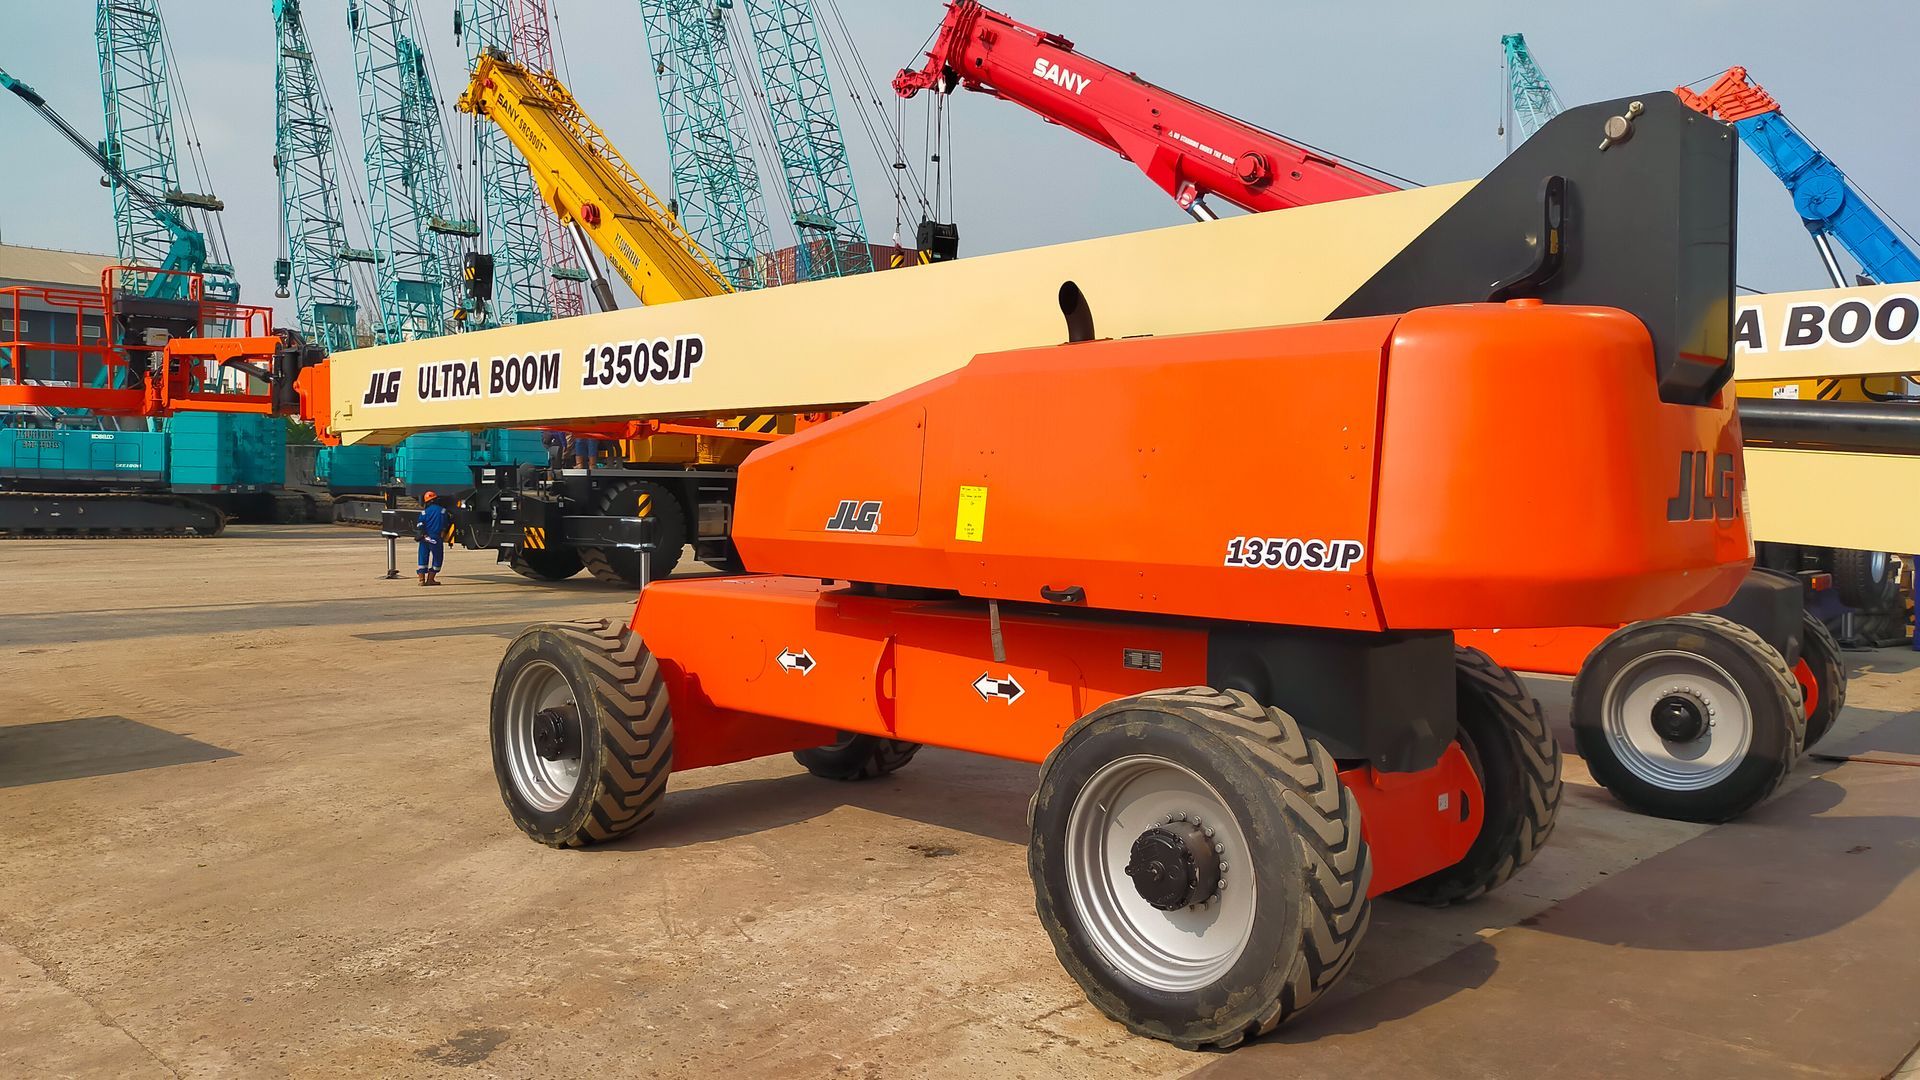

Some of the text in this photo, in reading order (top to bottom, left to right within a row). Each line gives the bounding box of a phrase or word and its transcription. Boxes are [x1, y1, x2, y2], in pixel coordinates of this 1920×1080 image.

[1032, 57, 1092, 96] SANY
[496, 93, 520, 122] SANY
[363, 337, 704, 405] JLG ULTRA BOOM 1350SJP
[1666, 450, 1734, 521] JLG
[826, 501, 881, 531] JLG
[1226, 538, 1362, 569] 1350SJP
